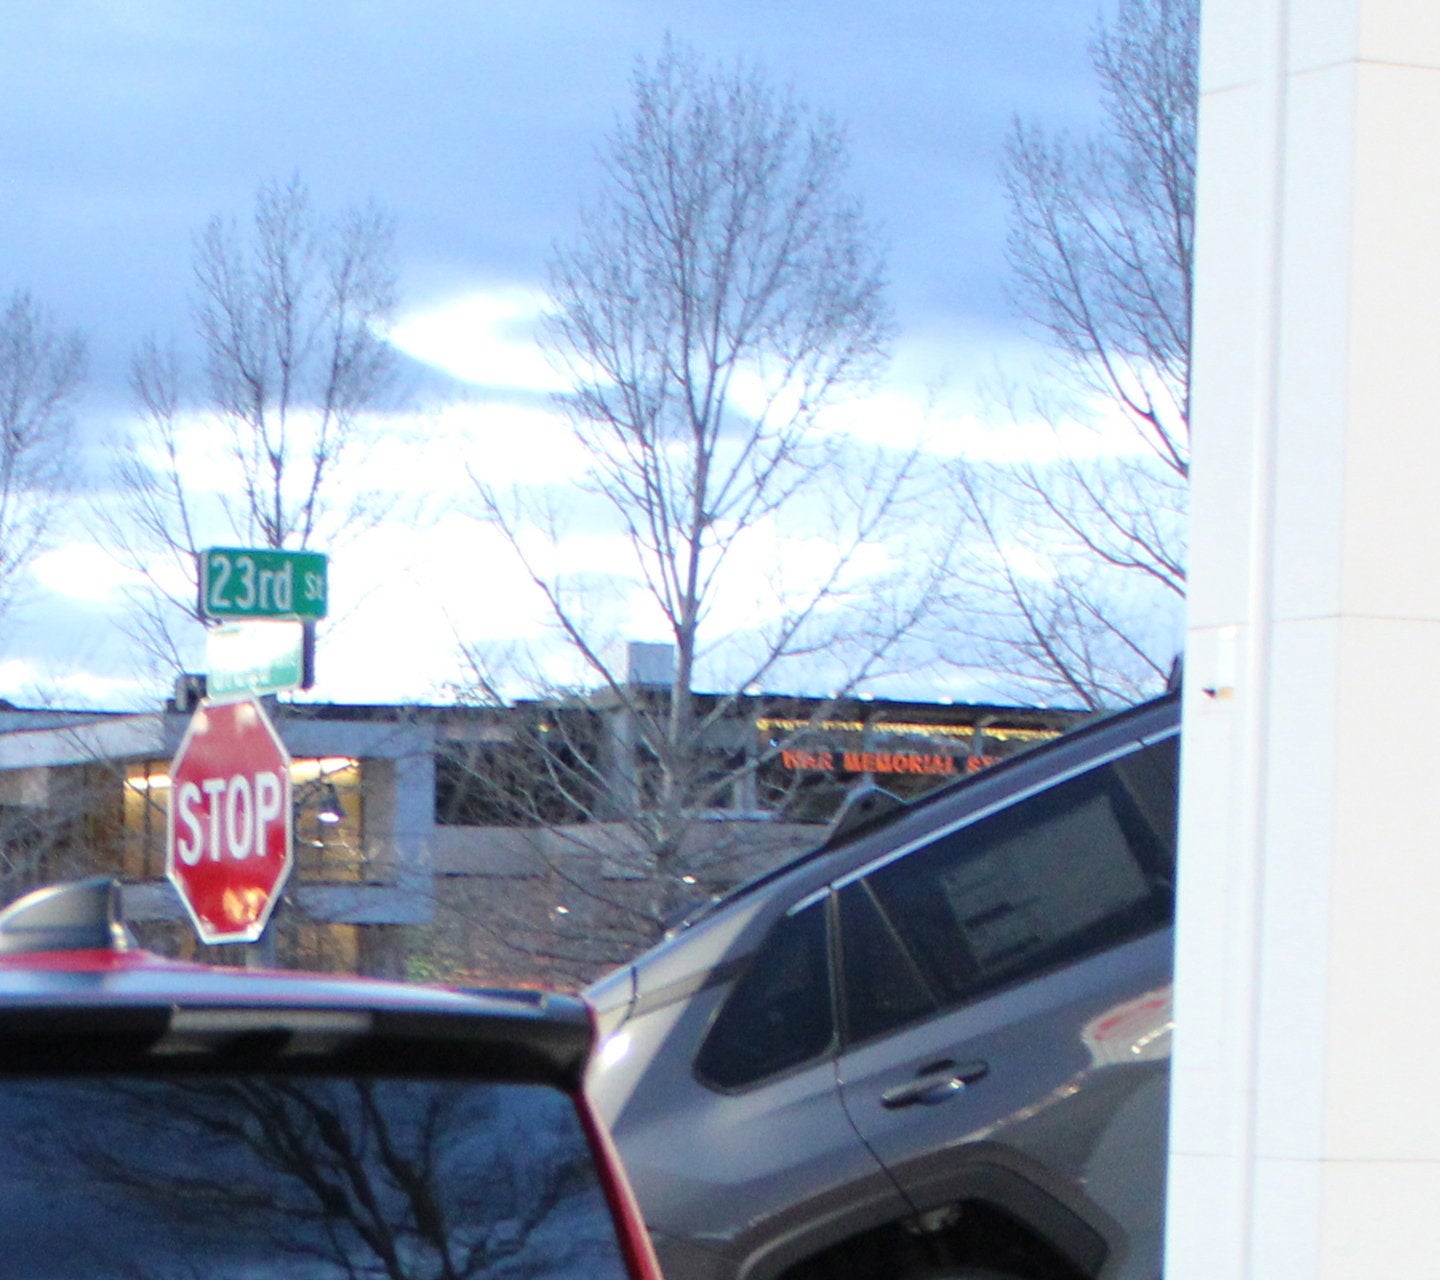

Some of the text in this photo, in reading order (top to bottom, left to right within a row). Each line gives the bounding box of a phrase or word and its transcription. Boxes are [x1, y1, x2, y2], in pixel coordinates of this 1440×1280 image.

[211, 555, 293, 611] 23rd
[843, 752, 954, 773] MEMORIAL
[178, 771, 281, 866] STOP
